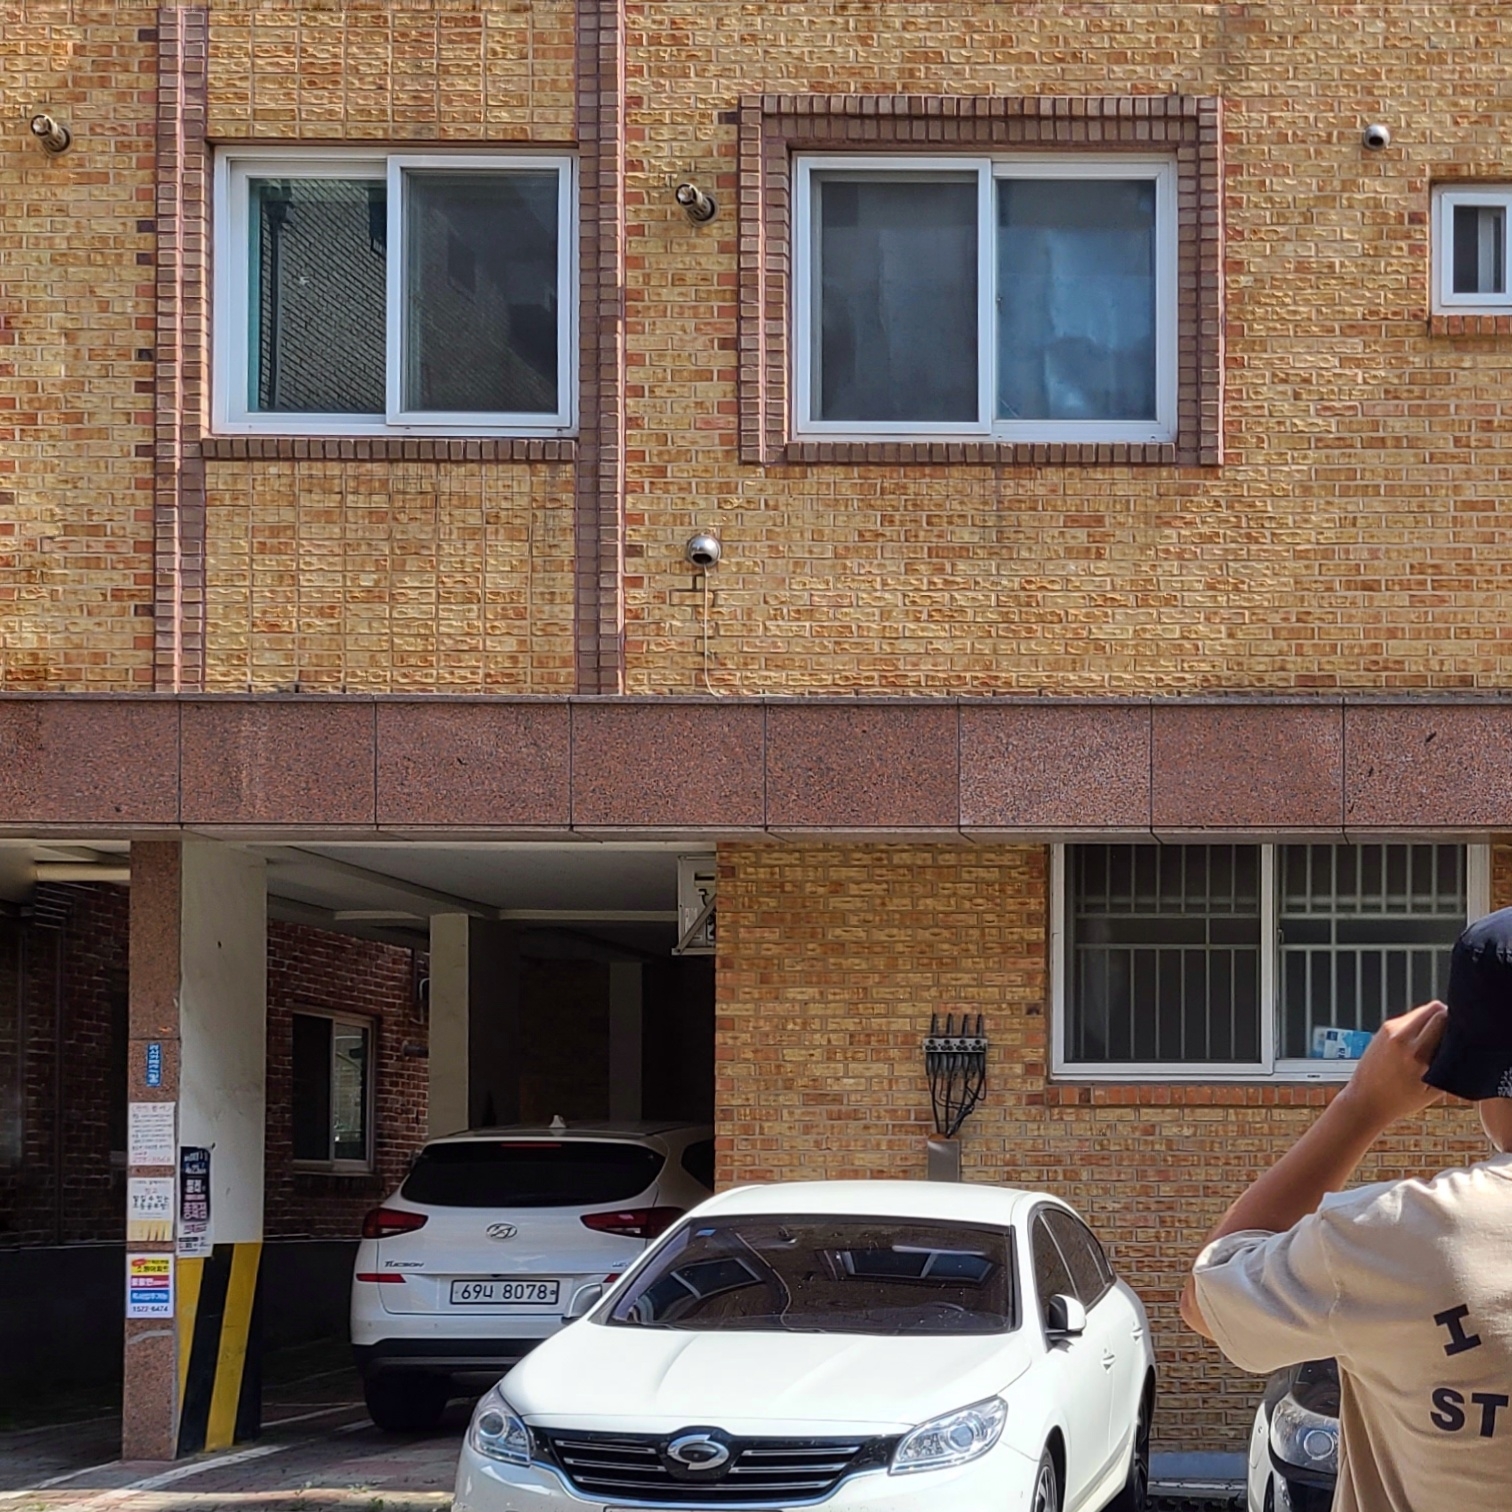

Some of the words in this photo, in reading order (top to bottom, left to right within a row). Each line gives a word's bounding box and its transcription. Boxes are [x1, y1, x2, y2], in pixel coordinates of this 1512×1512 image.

[384, 1260, 425, 1268] TUCSON
[461, 1283, 494, 1300] 69나
[502, 1283, 548, 1300] 8078
